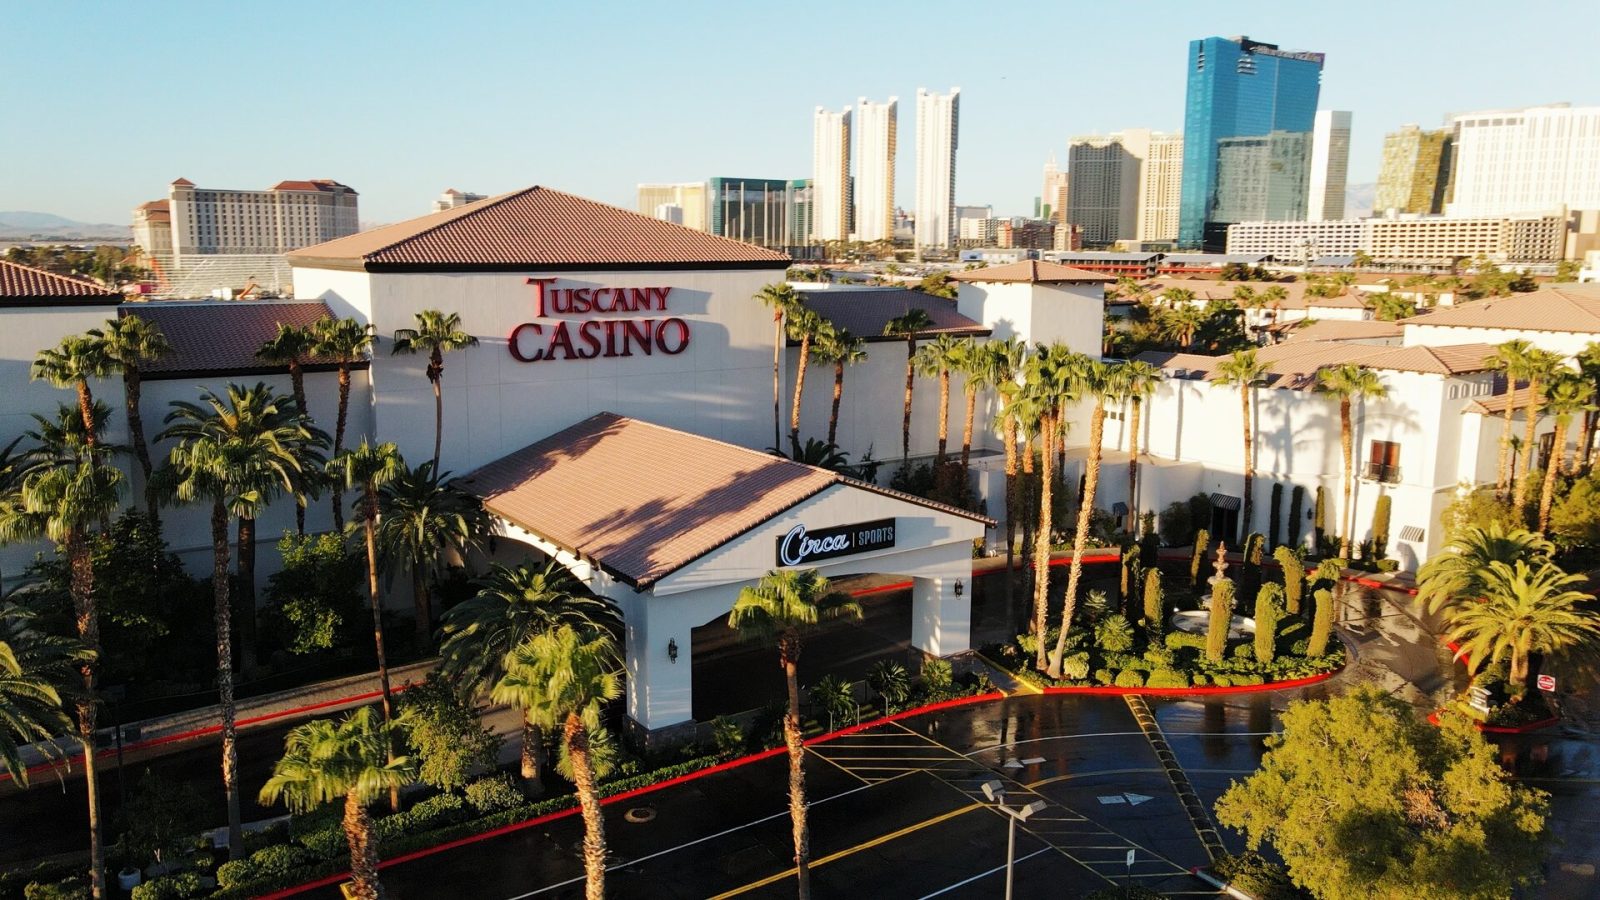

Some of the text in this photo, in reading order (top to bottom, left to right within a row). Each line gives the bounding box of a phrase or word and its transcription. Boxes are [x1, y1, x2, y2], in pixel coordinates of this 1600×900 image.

[526, 277, 672, 318] TUSCANY
[508, 317, 690, 363] CASINO
[780, 523, 893, 566] Circa SPORTS
